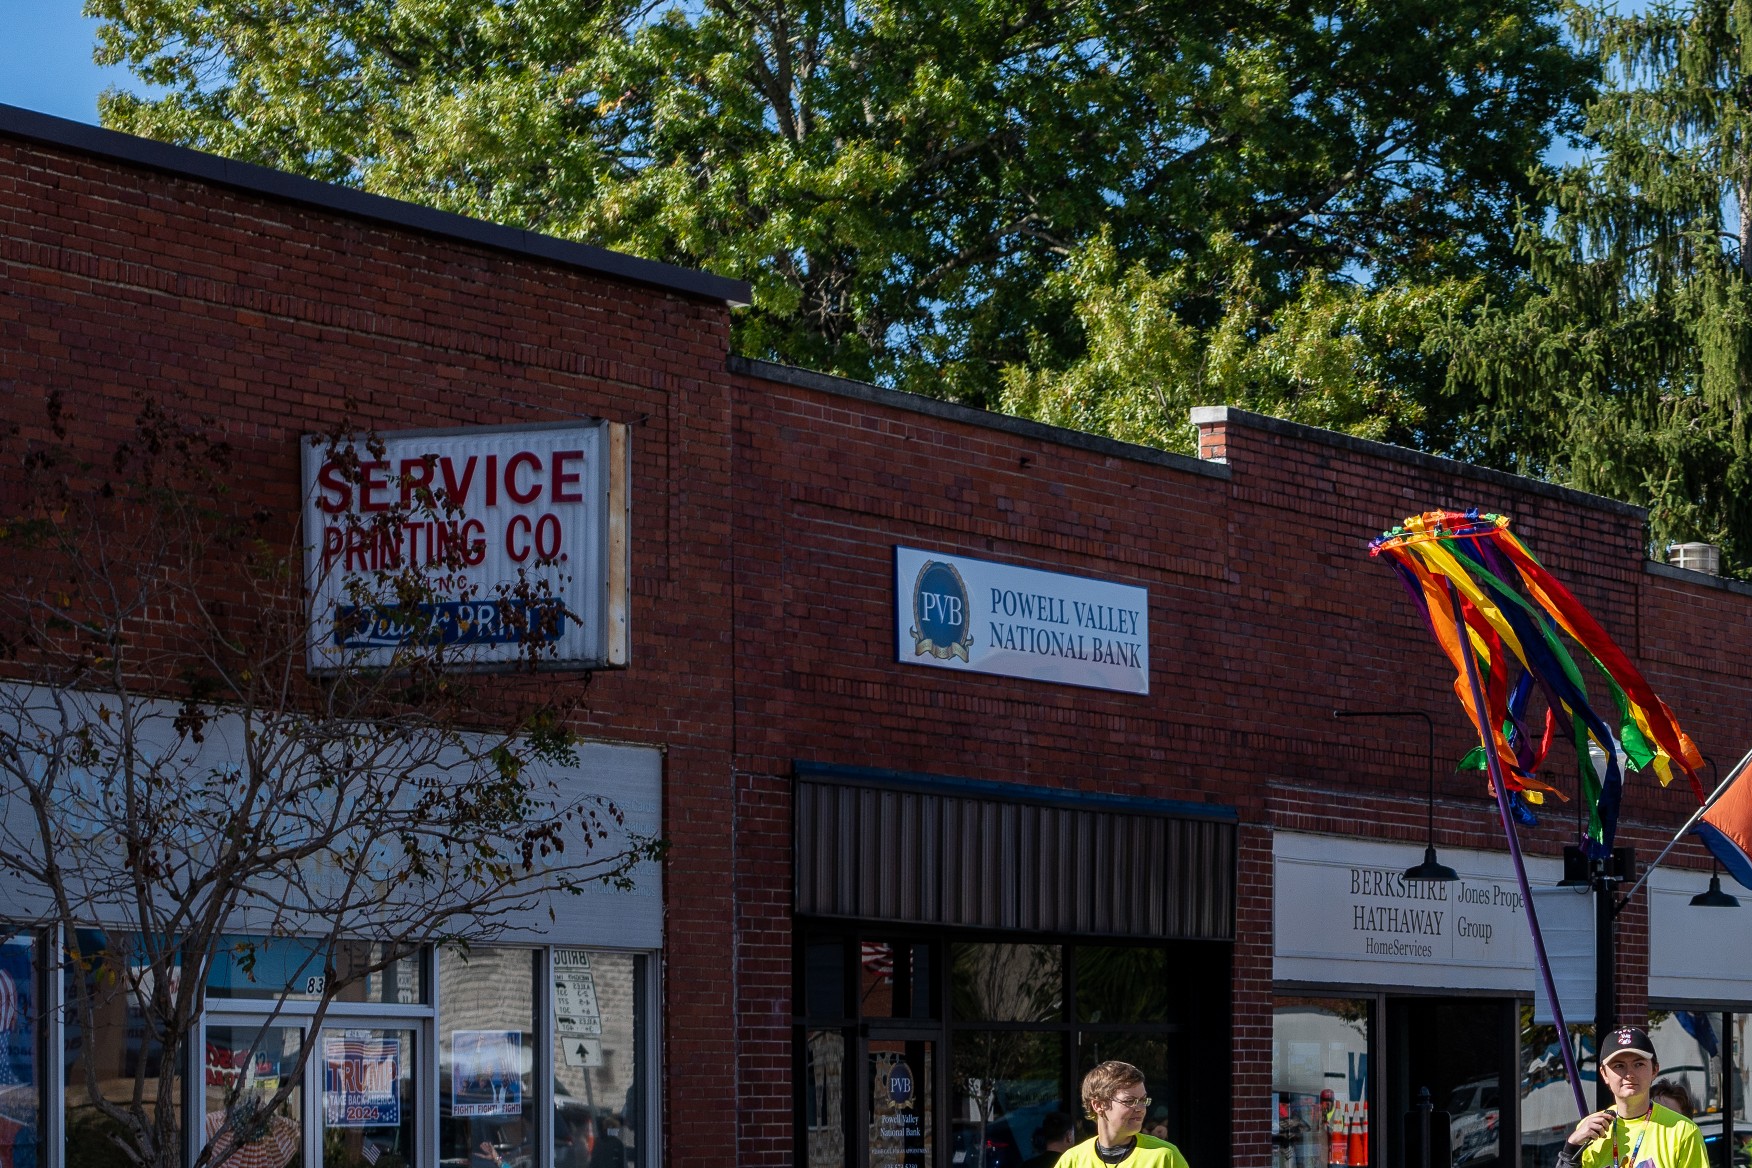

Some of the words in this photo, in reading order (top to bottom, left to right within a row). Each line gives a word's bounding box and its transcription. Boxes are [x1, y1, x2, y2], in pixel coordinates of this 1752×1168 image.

[320, 450, 584, 513] SERVICE
[323, 519, 487, 573] PRINTING
[506, 513, 568, 563] CO.
[922, 591, 962, 627] PVB
[990, 587, 1069, 625] POWELL
[1072, 600, 1140, 636] VALLEY
[989, 621, 1088, 661] NATIONAL
[1092, 637, 1142, 669] BANK
[1350, 869, 1448, 901] BERKSHIRE
[1457, 882, 1490, 905] Jones
[1353, 905, 1444, 936] HATHAWAY
[1457, 916, 1493, 944] Group
[1365, 937, 1432, 957] HomeServices
[329, 1059, 397, 1093] TRUMP
[890, 1077, 911, 1093] PVB
[347, 1106, 379, 1120] 2024
